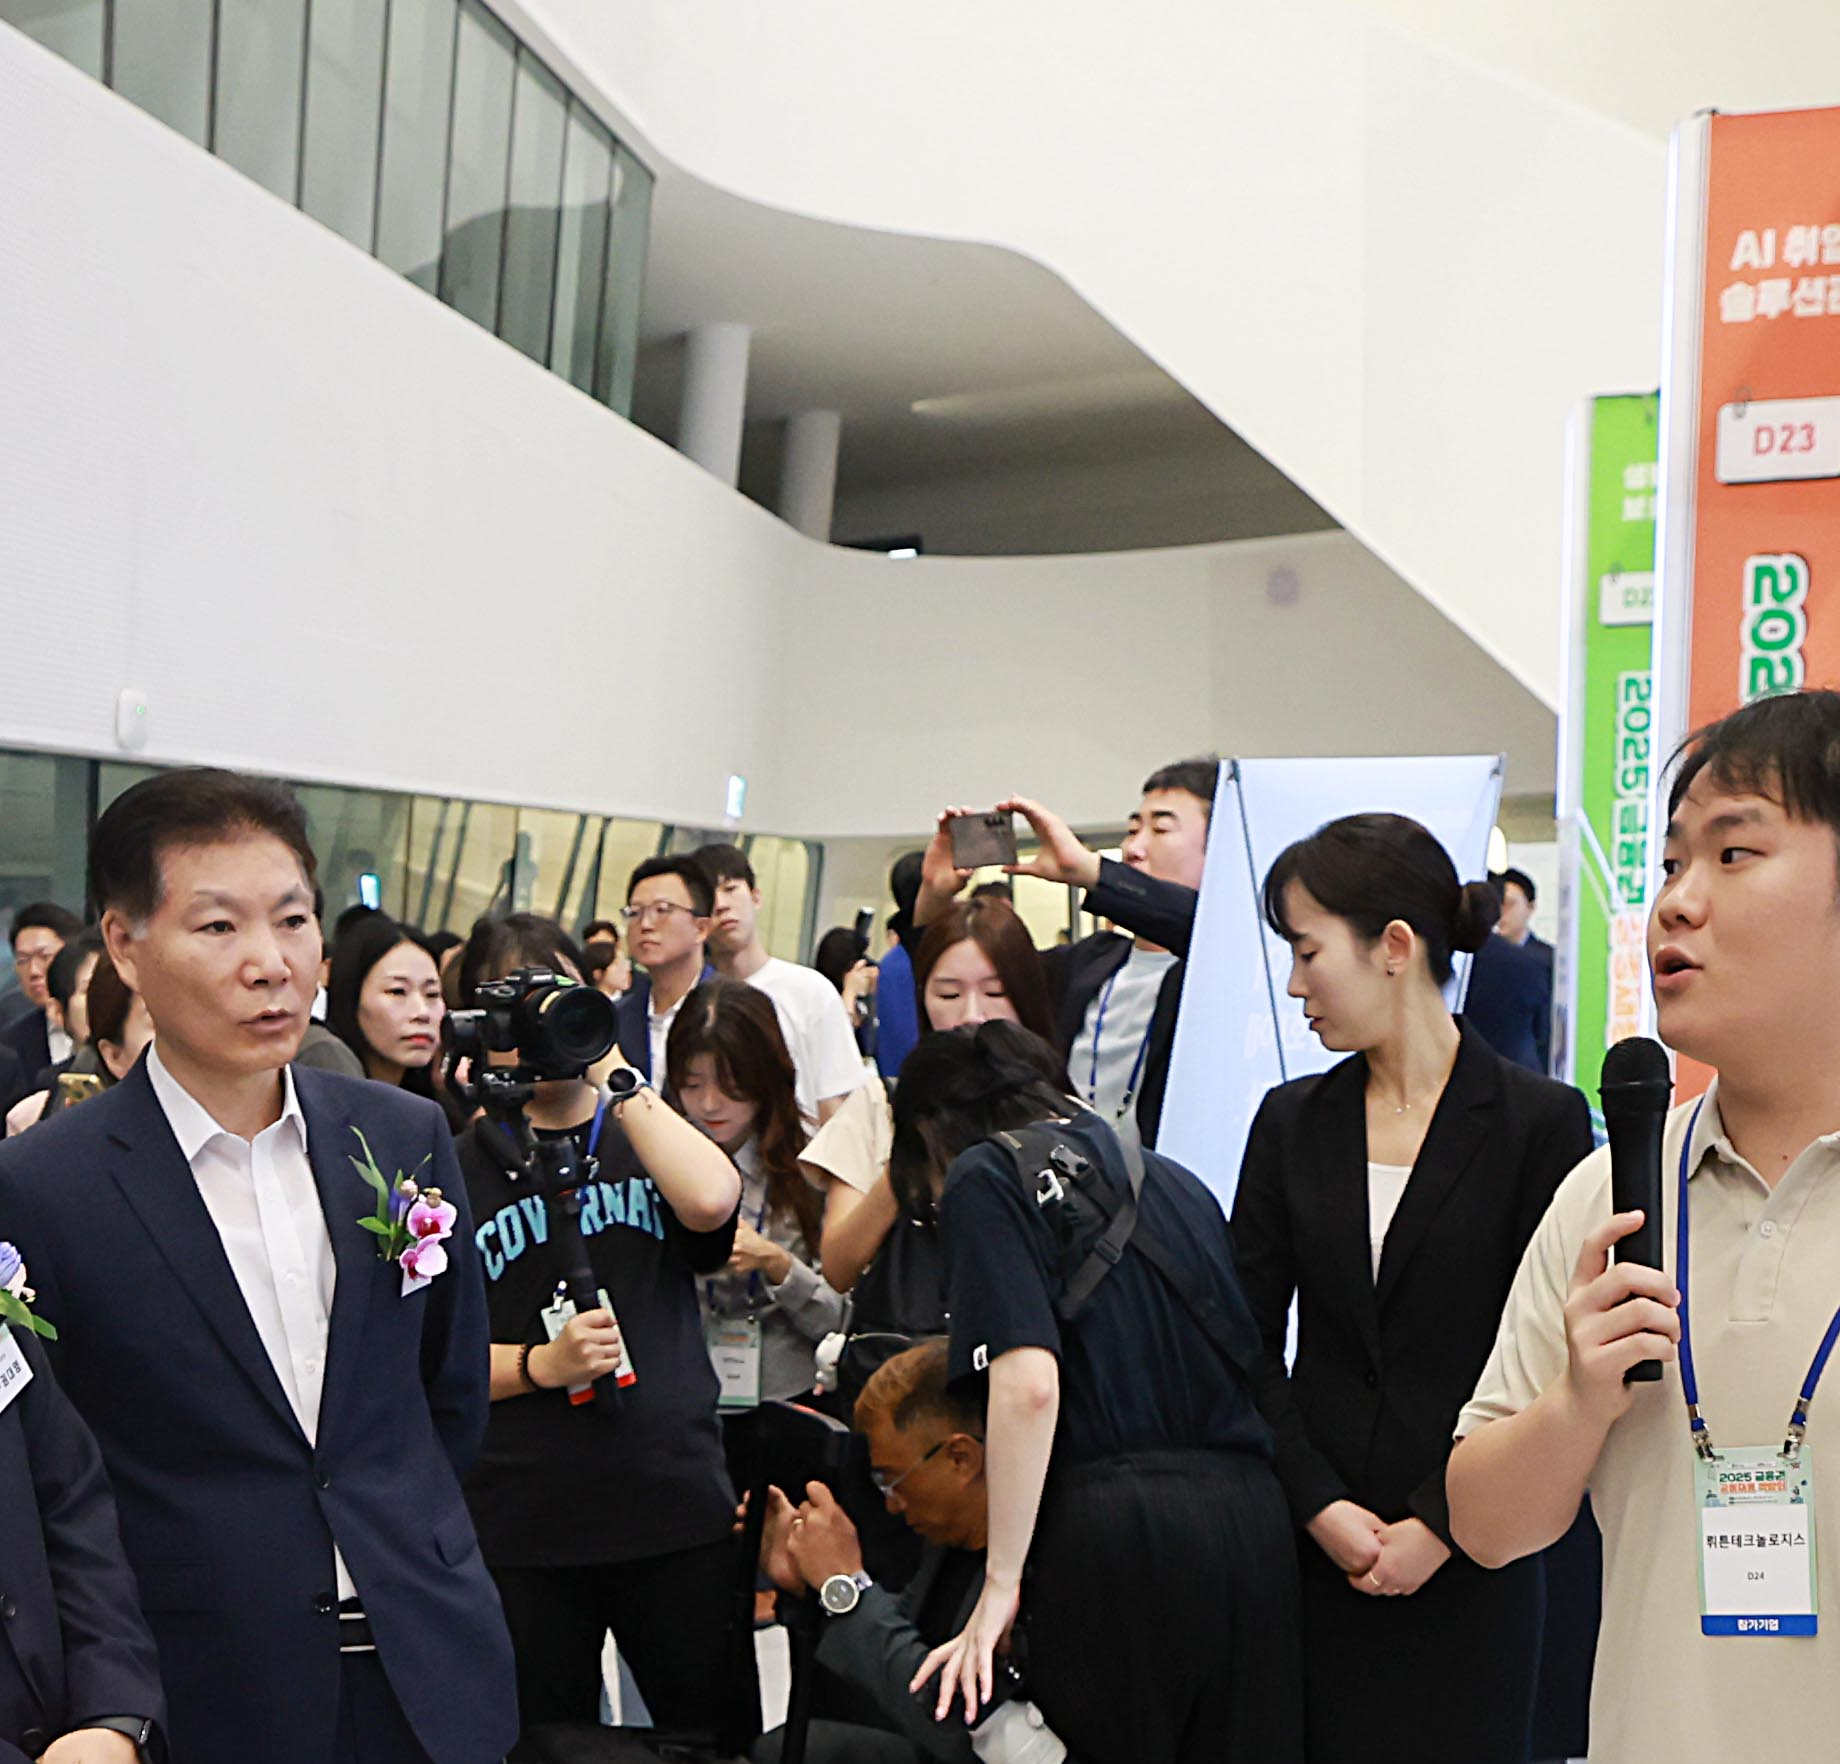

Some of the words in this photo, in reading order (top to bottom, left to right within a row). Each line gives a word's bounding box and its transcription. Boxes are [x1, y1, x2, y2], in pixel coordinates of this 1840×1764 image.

[1731, 229, 1776, 271] AI
[1753, 422, 1818, 456] D23
[1621, 675, 1652, 792] 2025
[475, 1177, 665, 1281] COVRNA
[1719, 1472, 1752, 1482] 2025
[1706, 1533, 1806, 1549] 뤼튼테크놀로지스
[1747, 1571, 1765, 1581] D24
[1737, 1619, 1779, 1631] 참가기업
